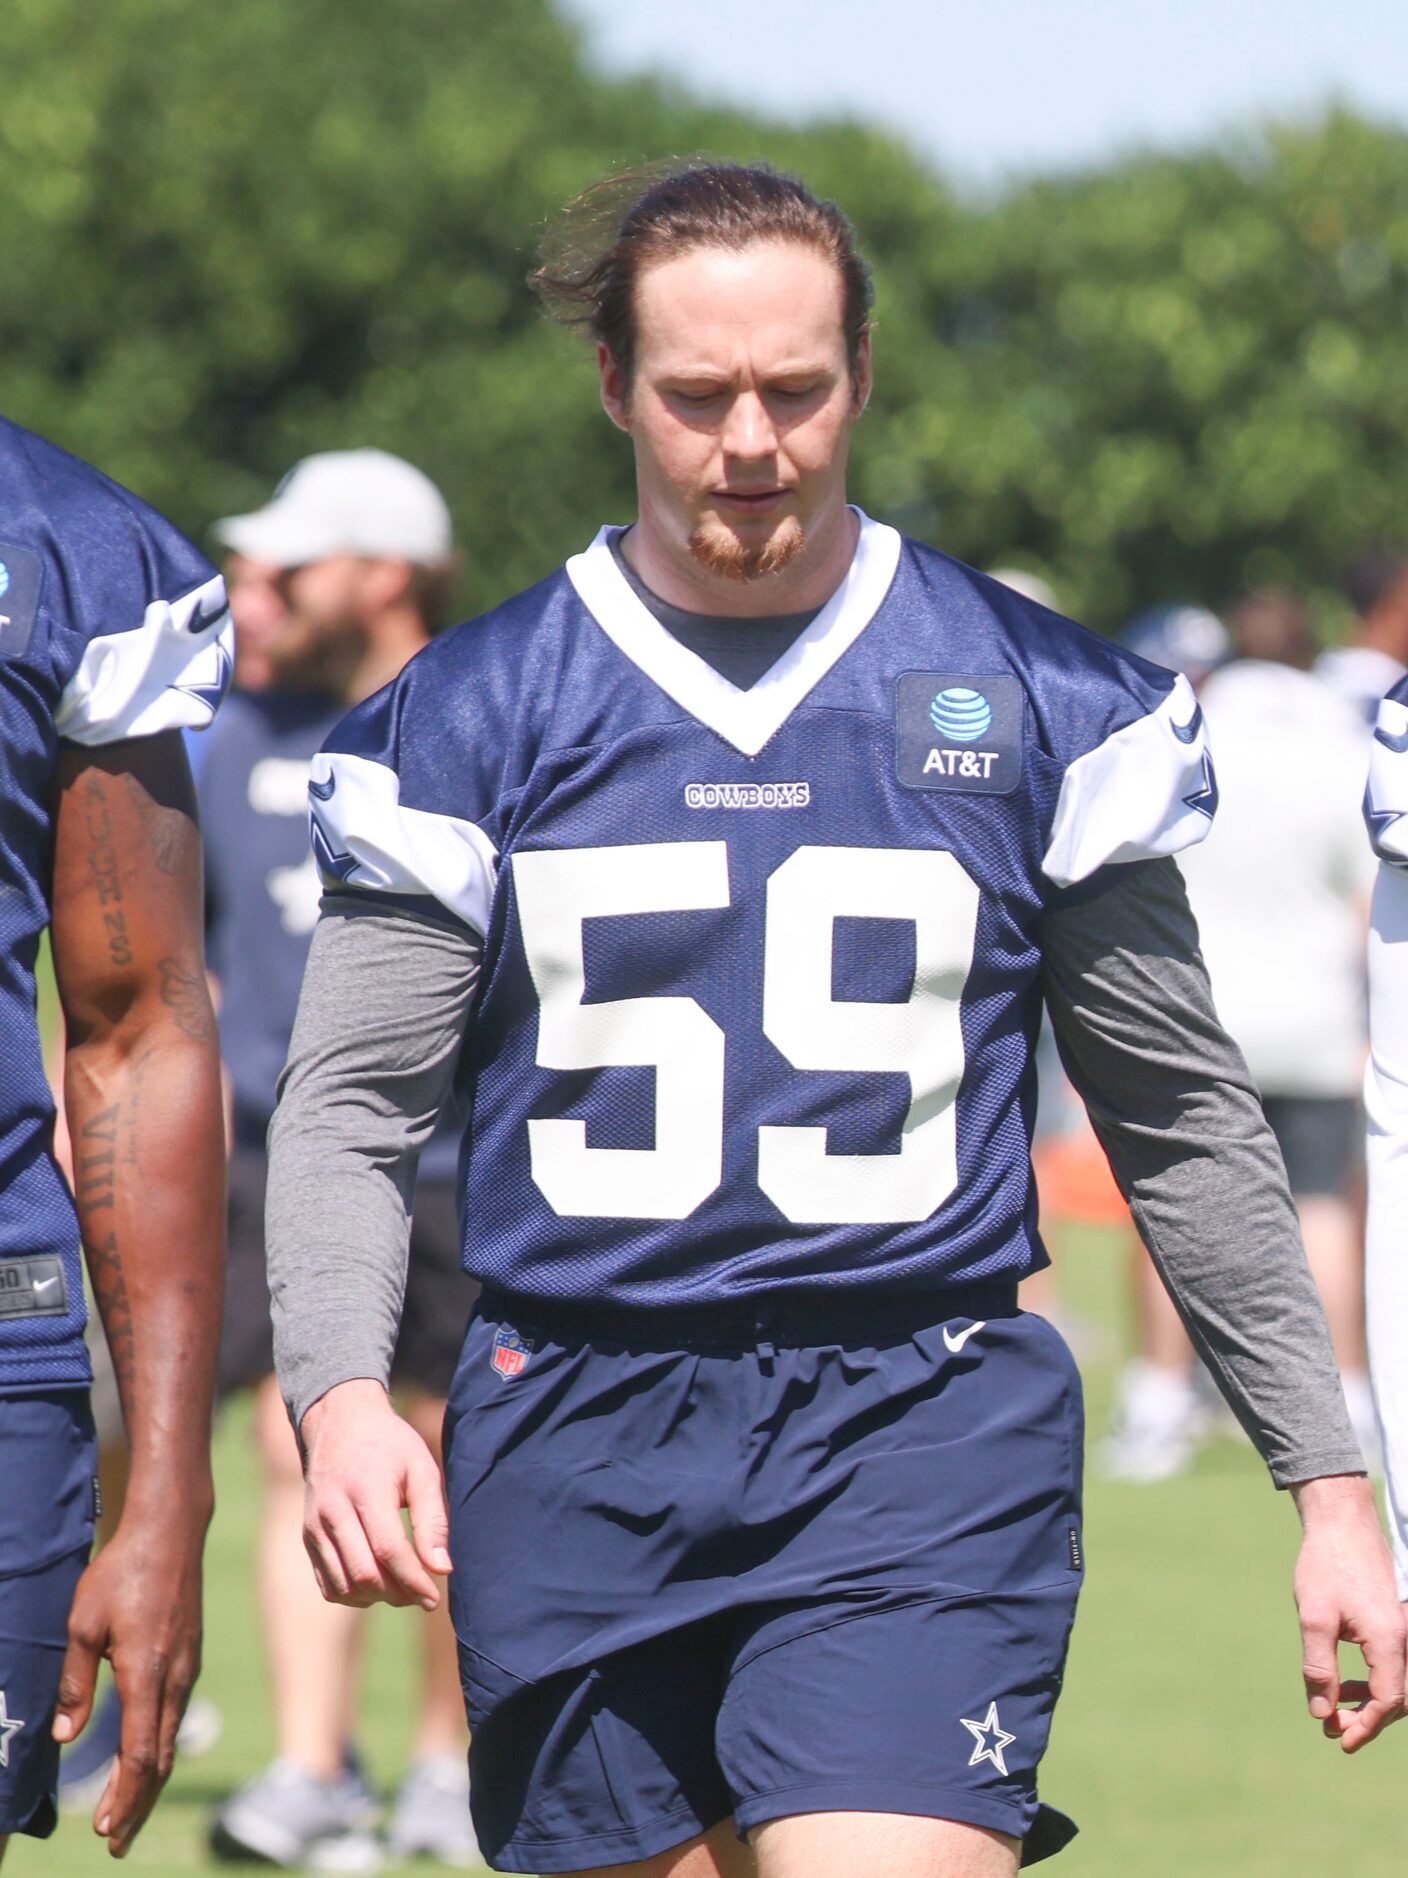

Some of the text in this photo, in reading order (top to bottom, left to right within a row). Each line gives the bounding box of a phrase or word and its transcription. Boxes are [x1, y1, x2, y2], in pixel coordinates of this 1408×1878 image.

[923, 748, 999, 779] AT&T
[685, 782, 810, 808] COWBOYS
[511, 840, 980, 1223] 59
